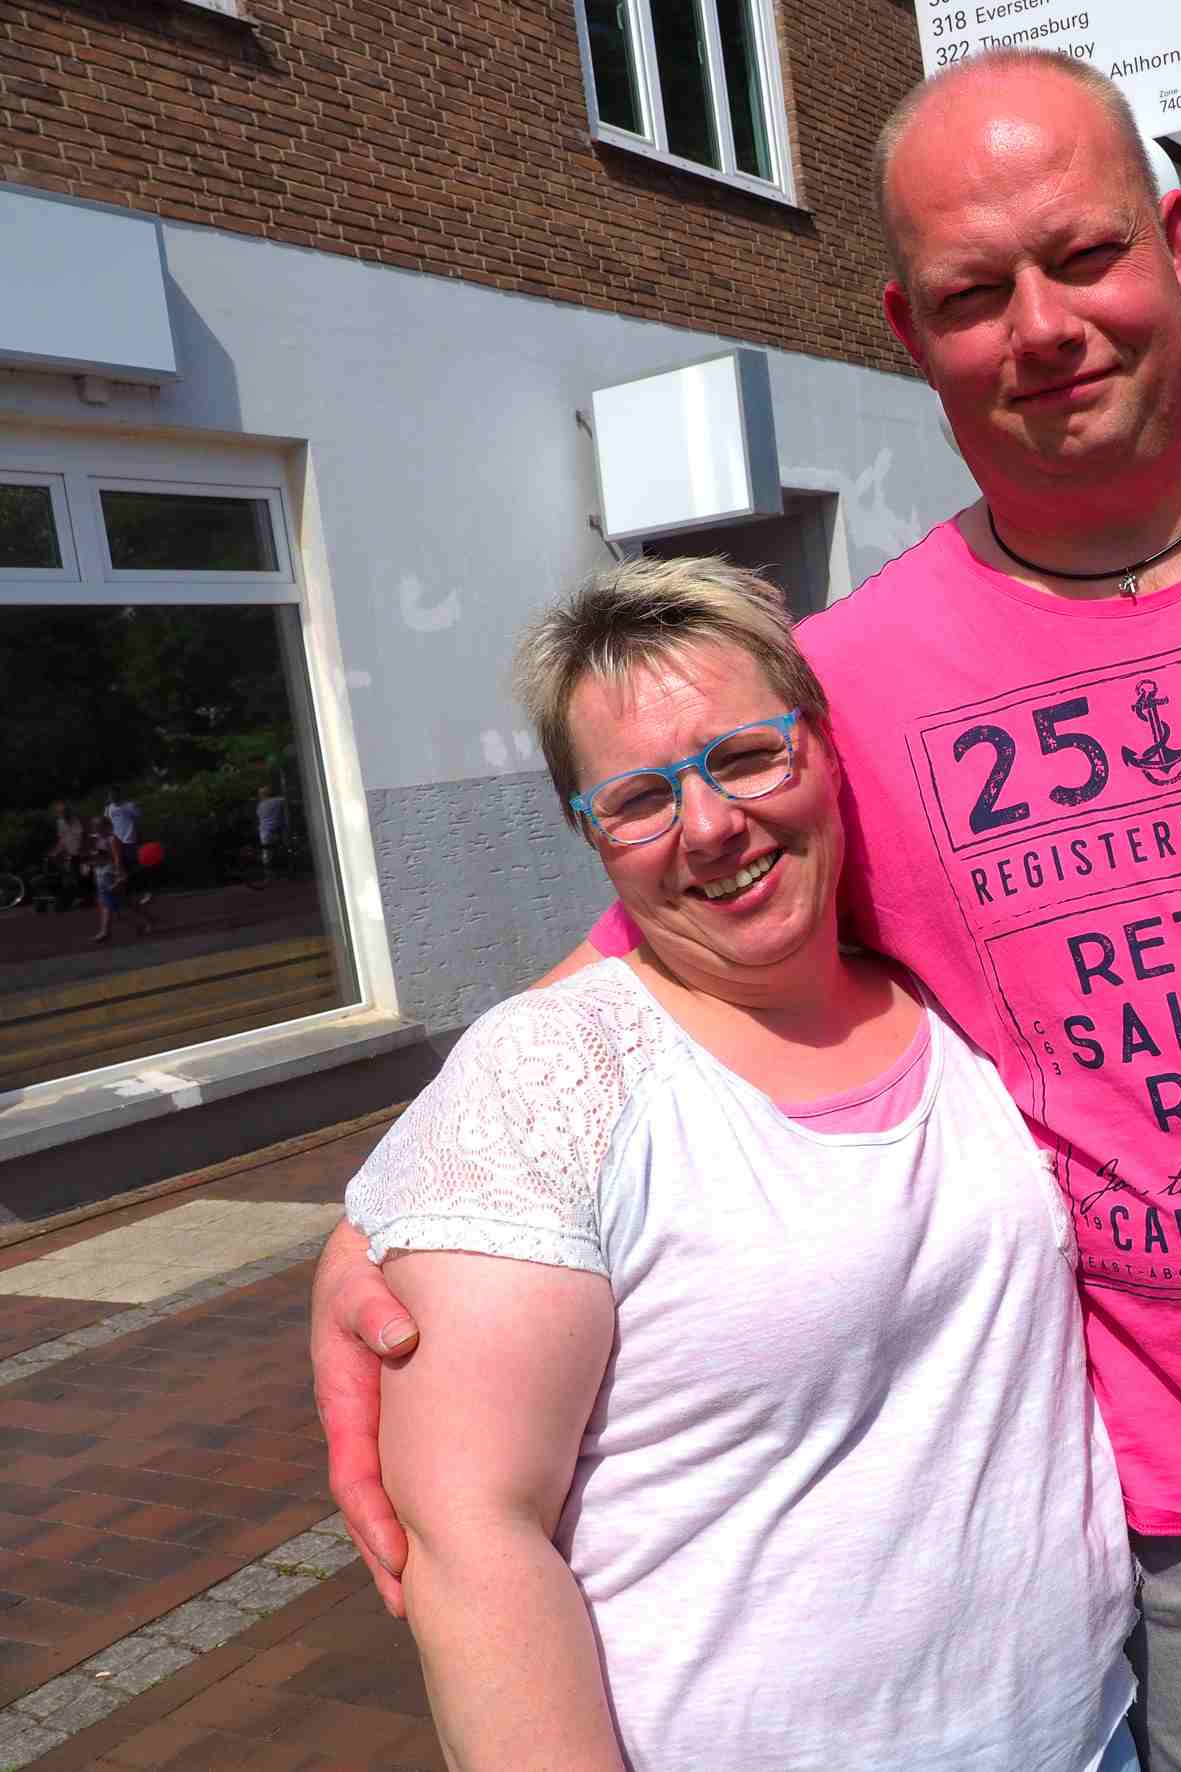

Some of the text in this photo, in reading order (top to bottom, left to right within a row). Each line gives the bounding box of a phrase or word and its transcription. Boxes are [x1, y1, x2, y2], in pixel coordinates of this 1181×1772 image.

[932, 10, 967, 36] 318
[936, 12, 1090, 66] 322 Thomasburg
[1109, 50, 1181, 79] Ahlhorn
[952, 697, 1111, 835] 25
